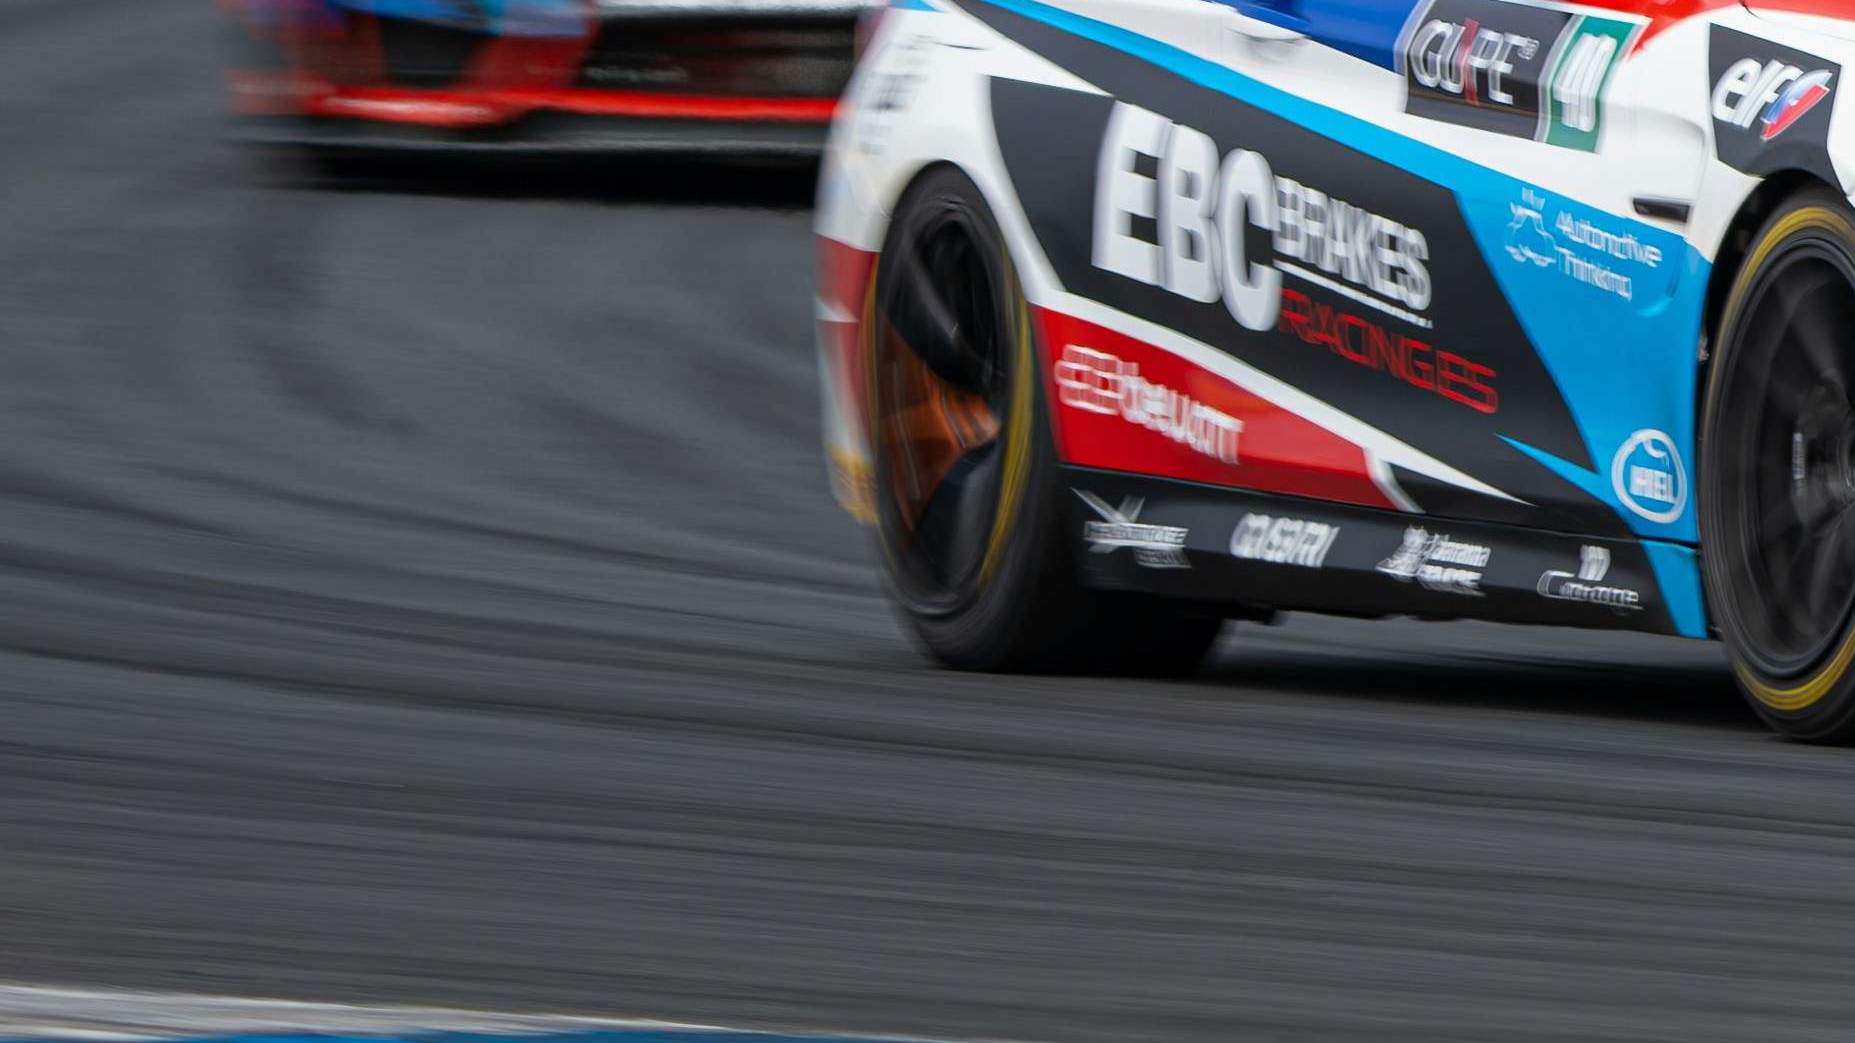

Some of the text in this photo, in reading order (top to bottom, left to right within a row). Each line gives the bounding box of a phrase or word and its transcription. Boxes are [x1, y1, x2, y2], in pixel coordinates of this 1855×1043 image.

[1711, 57, 1804, 128] elf
[1091, 99, 1283, 331] EBC
[1629, 464, 1679, 506] HEL
